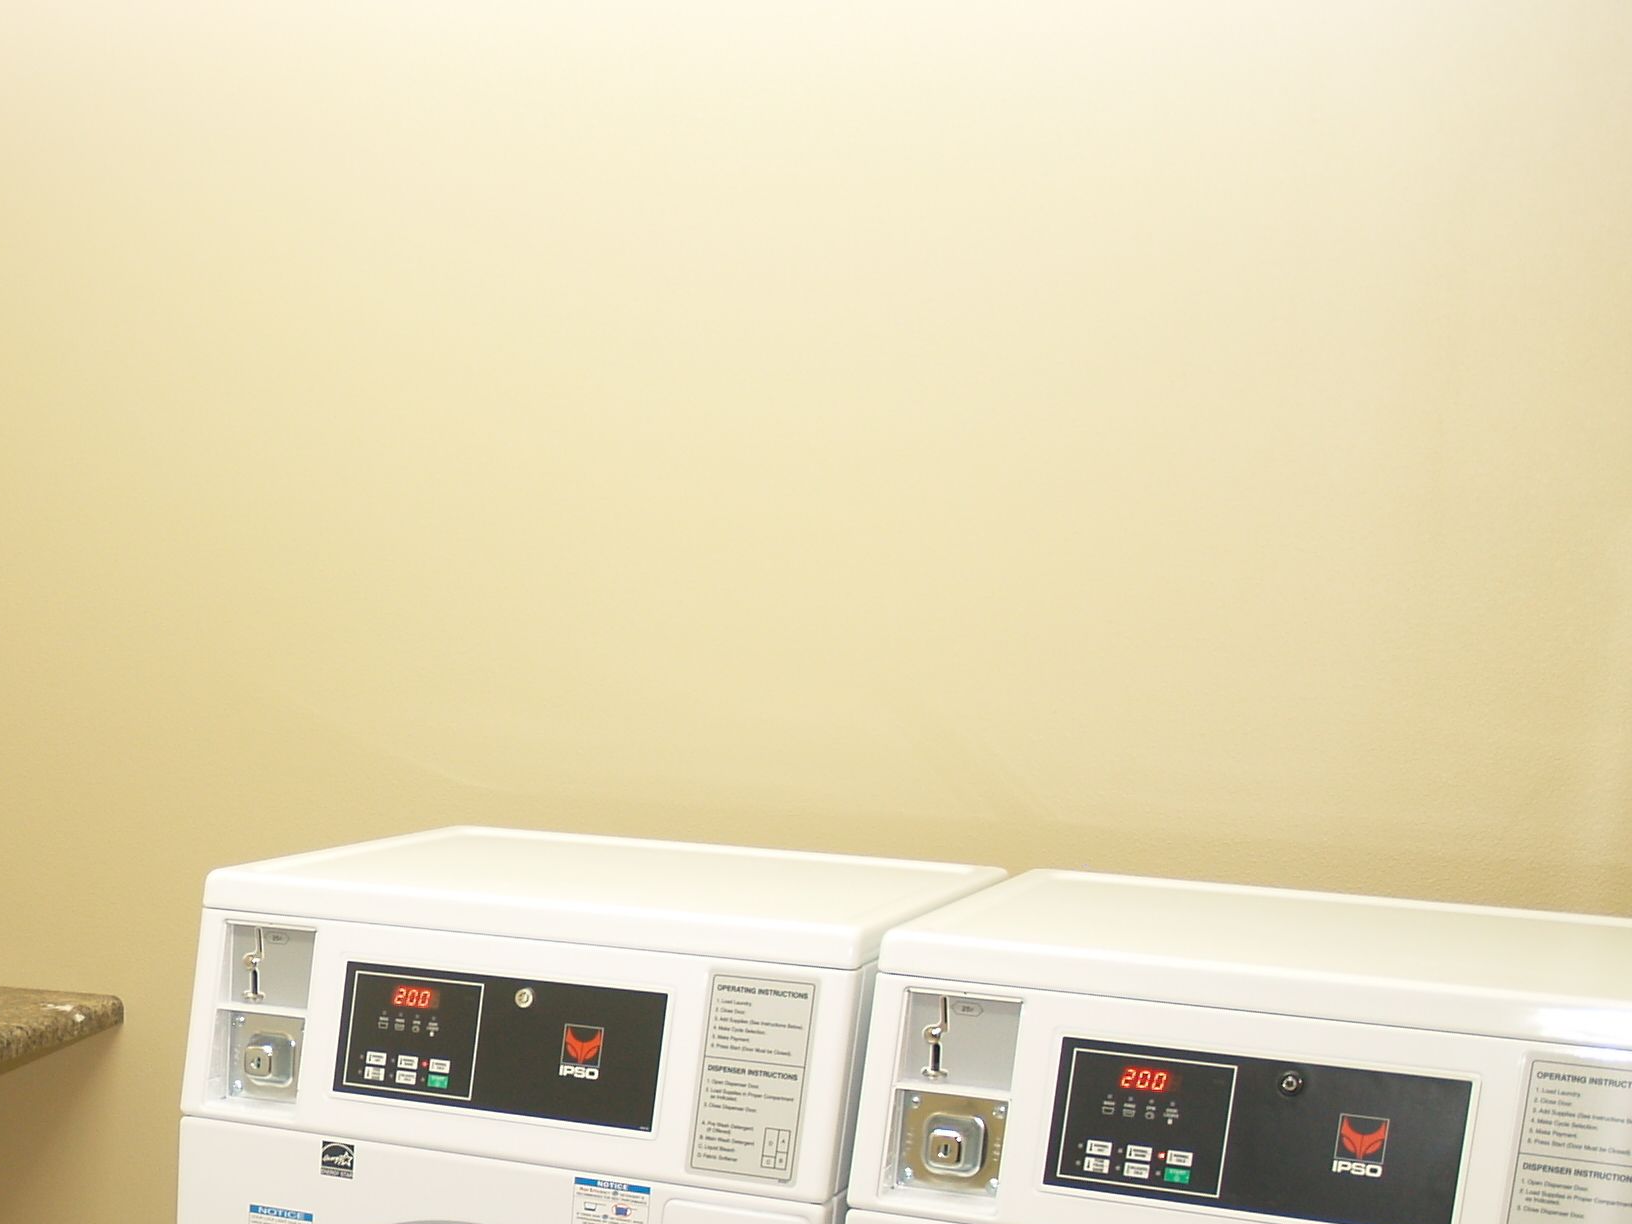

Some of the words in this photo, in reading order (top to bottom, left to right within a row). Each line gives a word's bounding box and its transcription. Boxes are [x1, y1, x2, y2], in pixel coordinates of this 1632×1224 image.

[393, 987, 431, 1007] 200
[717, 984, 756, 994] OPERATING
[757, 988, 808, 999] INSTRUCTIONS
[558, 1064, 599, 1080] IPSO
[707, 1064, 746, 1075] DISPENSER
[747, 1069, 798, 1081] INSTRUCTIONS
[1120, 1068, 1167, 1090] 200
[1536, 1071, 1586, 1083] OPERATING
[1588, 1076, 1632, 1088] INSTRUCT
[1331, 1160, 1382, 1178] IPSO
[1522, 1162, 1572, 1175] DISPENSER
[1573, 1168, 1632, 1182] INSTRUCTION
[596, 1181, 629, 1191] NOTICE
[257, 1206, 305, 1219] NOTICE
